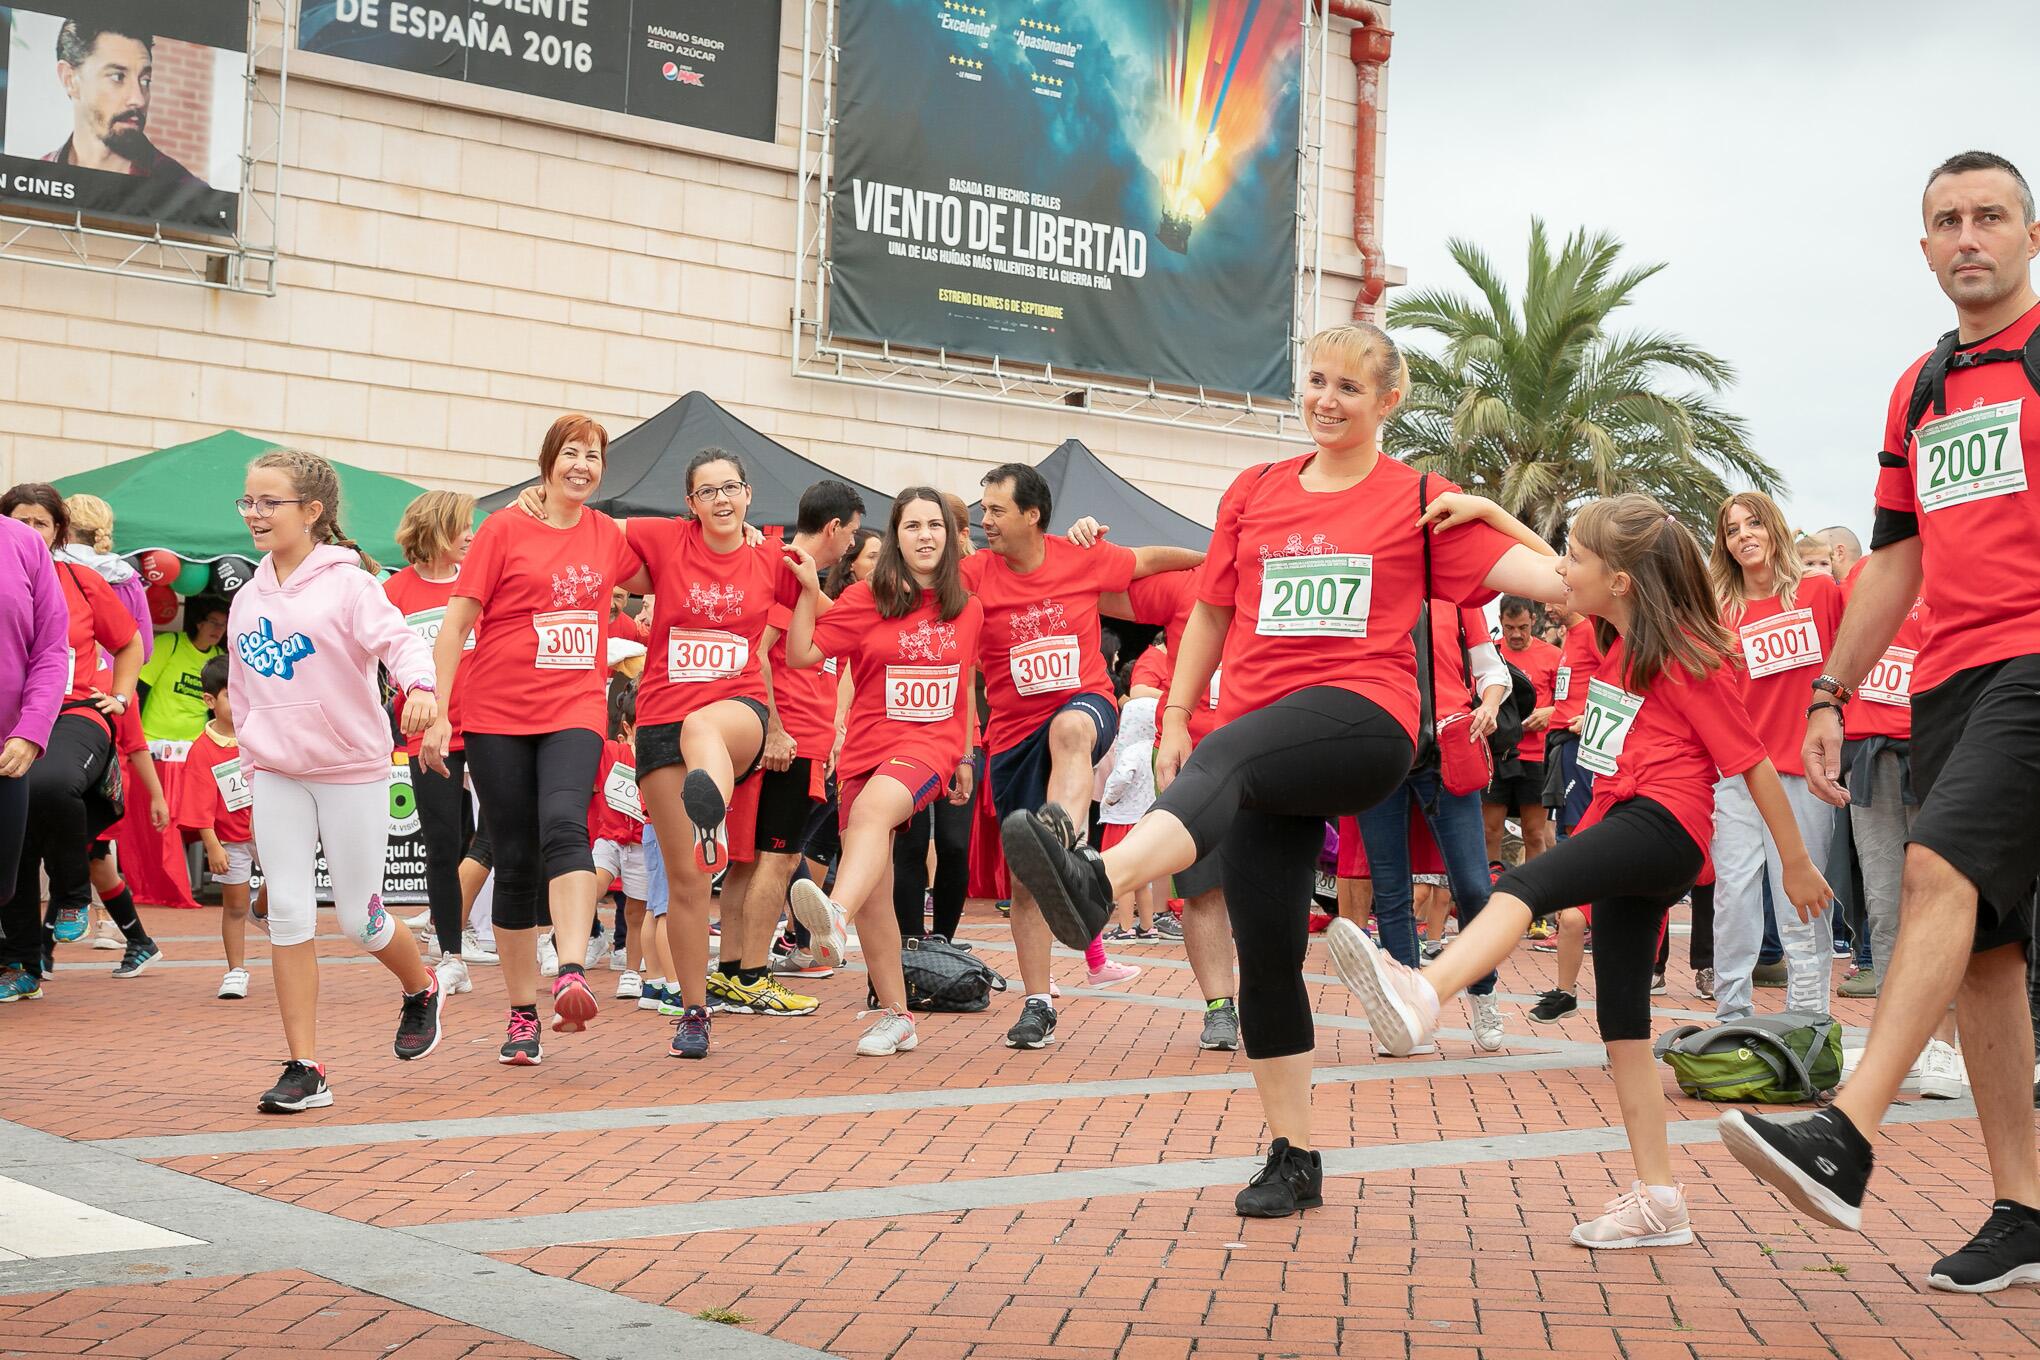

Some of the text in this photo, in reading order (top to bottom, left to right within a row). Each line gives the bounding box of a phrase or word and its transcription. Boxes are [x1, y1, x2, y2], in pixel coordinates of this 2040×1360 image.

[335, 0, 593, 73] DE ESPAÑA 2016
[647, 25, 725, 51] MÁXIMO SABOR
[647, 38, 716, 62] ZERO AZÚCAR
[14, 176, 75, 199] CINES
[949, 177, 1061, 211] BASADA EN HECHOS REALES
[853, 178, 1147, 279] VIENTO DE LIBERTAD
[888, 241, 1112, 290] UNA DE LAS HUÍDAS MÁS VALIENTES DE LA GUERRA FRÍA
[938, 288, 972, 305] ESTRENO
[972, 293, 983, 307] EN
[983, 295, 1004, 310] CINES
[1004, 299, 1011, 311] 6
[1010, 301, 1022, 313] DE
[1021, 301, 1064, 320] SEPTIEMBRE
[1929, 427, 2009, 488] 2007
[1272, 577, 1362, 617] 2007
[546, 626, 593, 654] 3001
[676, 642, 736, 669] 3001
[1752, 626, 1809, 663] 3001
[1018, 651, 1071, 683] 3001
[895, 682, 950, 708] 3001
[1585, 703, 1624, 750] 07
